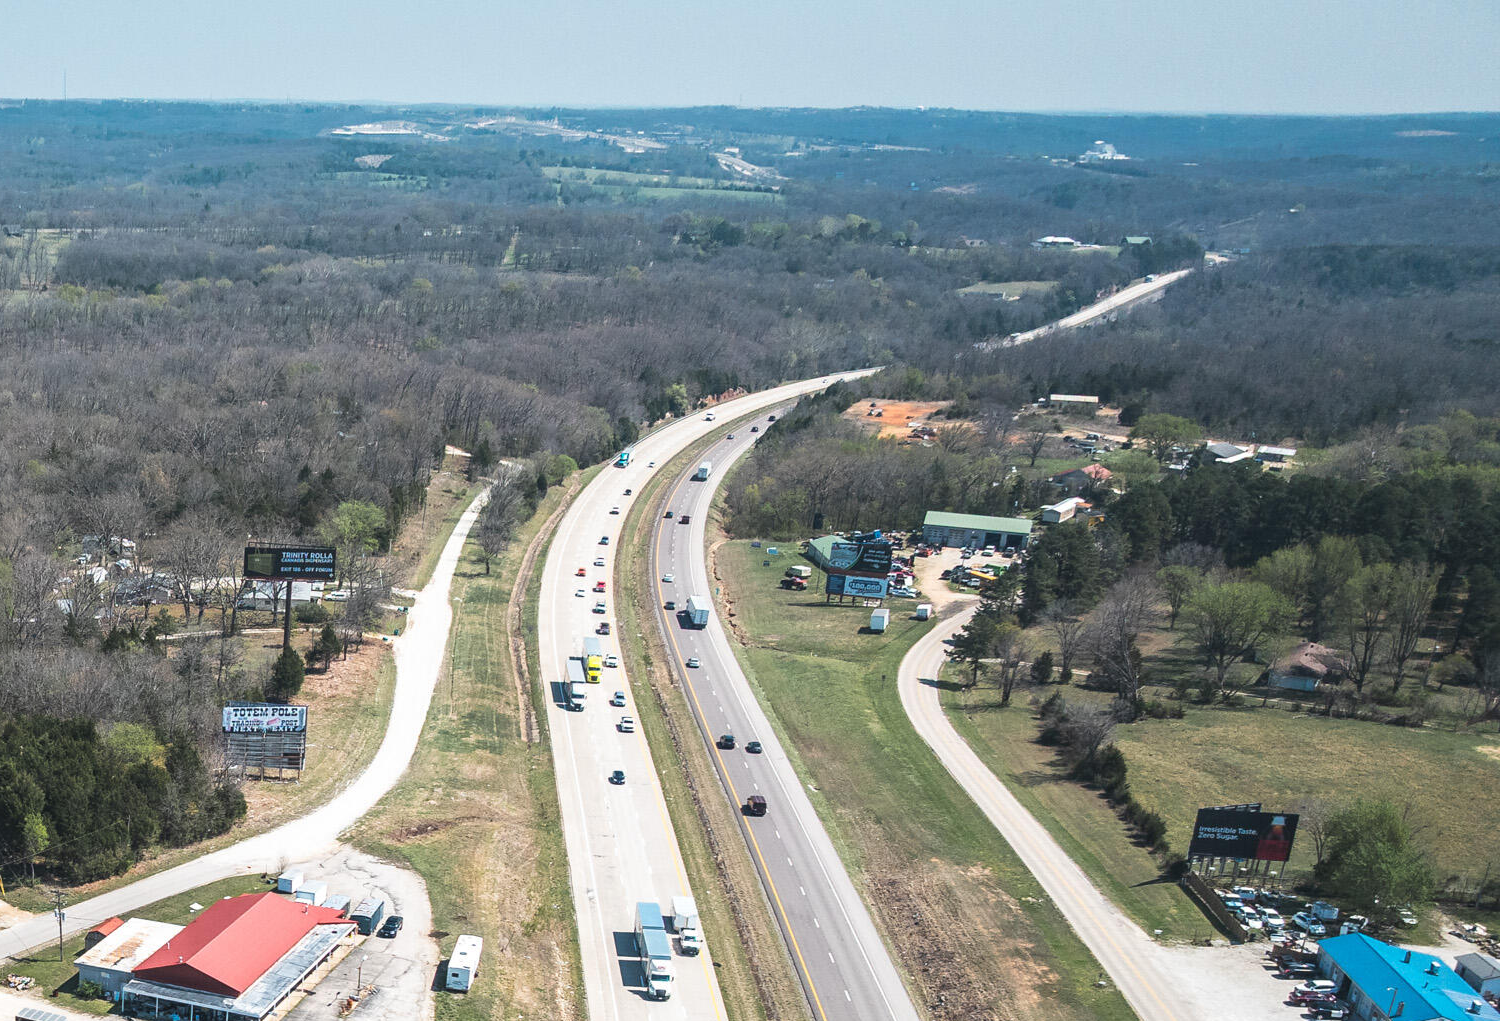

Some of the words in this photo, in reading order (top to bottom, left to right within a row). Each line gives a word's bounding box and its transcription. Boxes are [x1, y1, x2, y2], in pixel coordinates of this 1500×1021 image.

[233, 708, 268, 717] TOTEM
[271, 708, 298, 717] POLE
[1199, 826, 1237, 834] Irresistible
[1198, 831, 1215, 839] Zero
